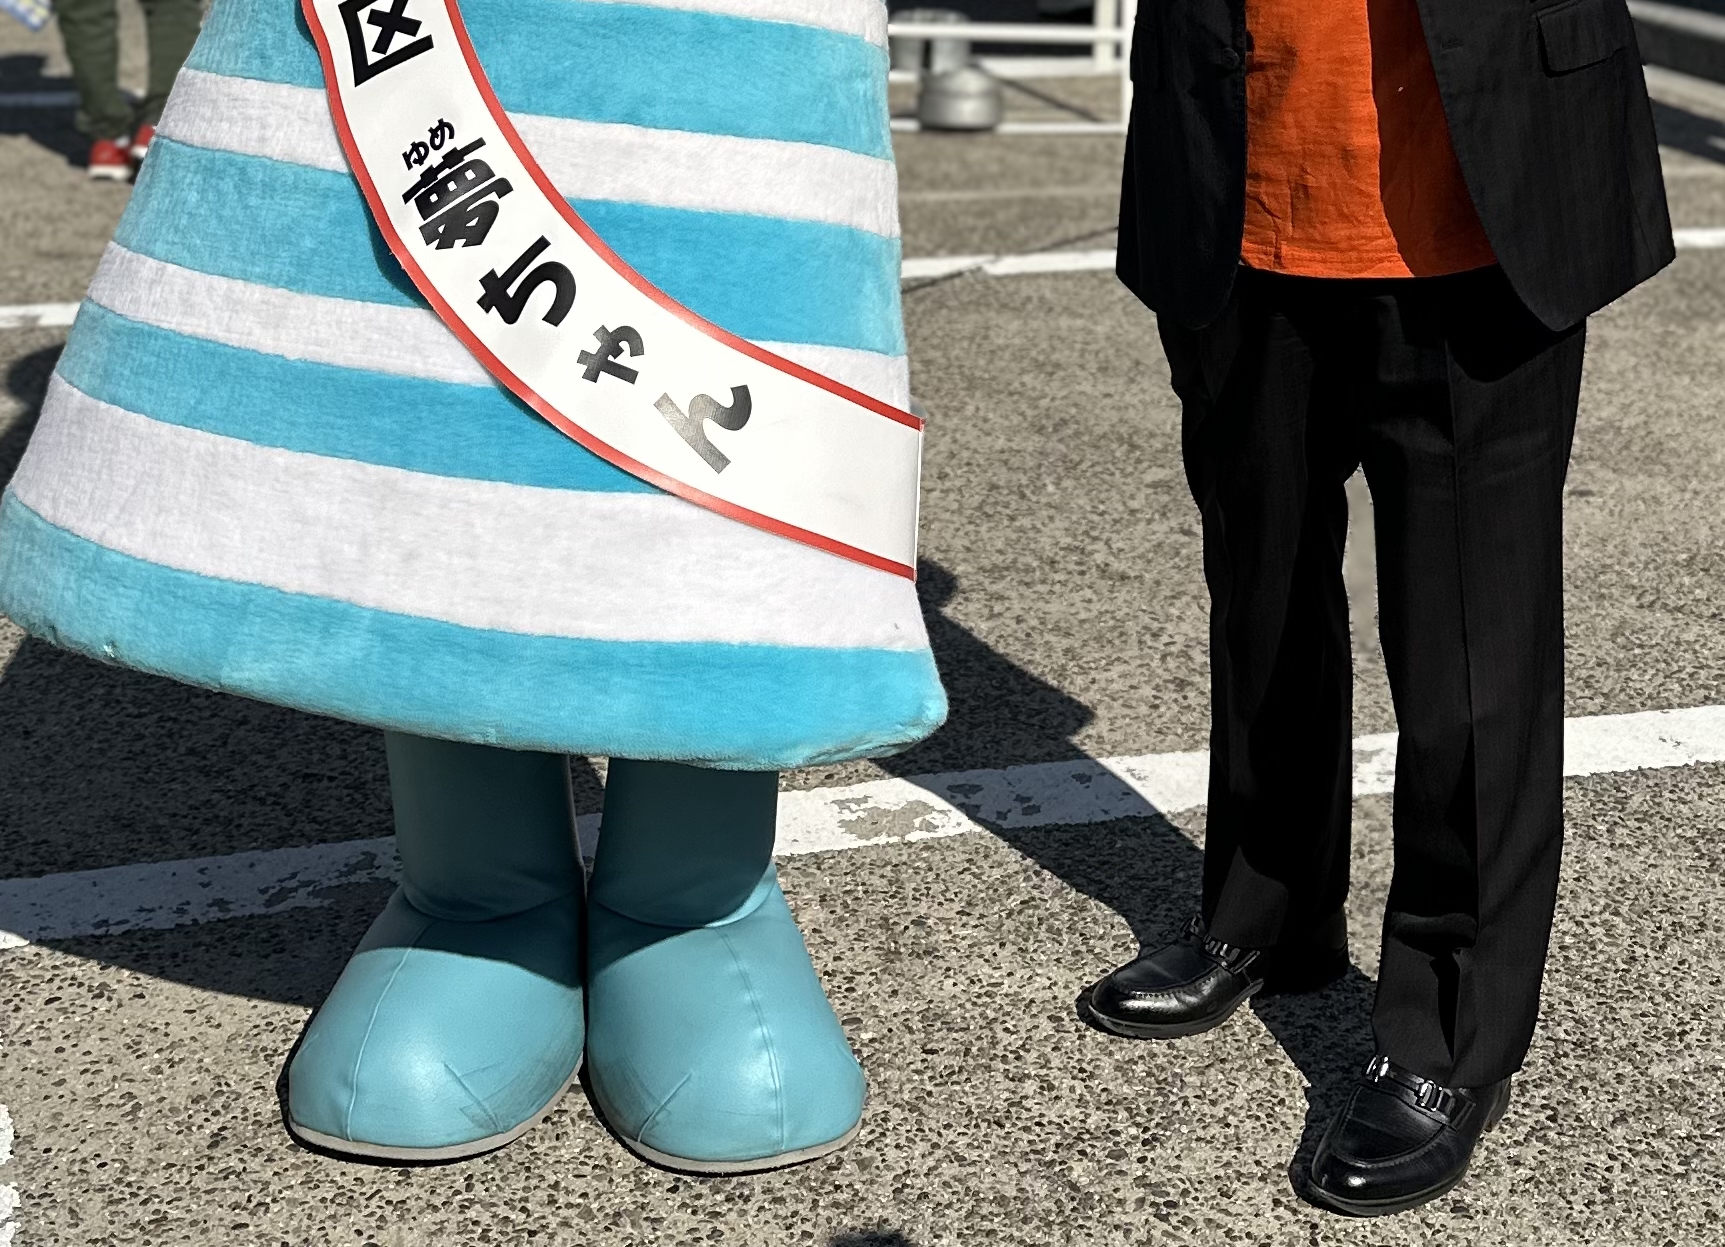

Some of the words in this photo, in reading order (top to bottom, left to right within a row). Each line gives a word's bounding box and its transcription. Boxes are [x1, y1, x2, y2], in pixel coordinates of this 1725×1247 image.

[401, 118, 455, 172] ゆめ
[402, 137, 753, 475] 夢ちゃん
